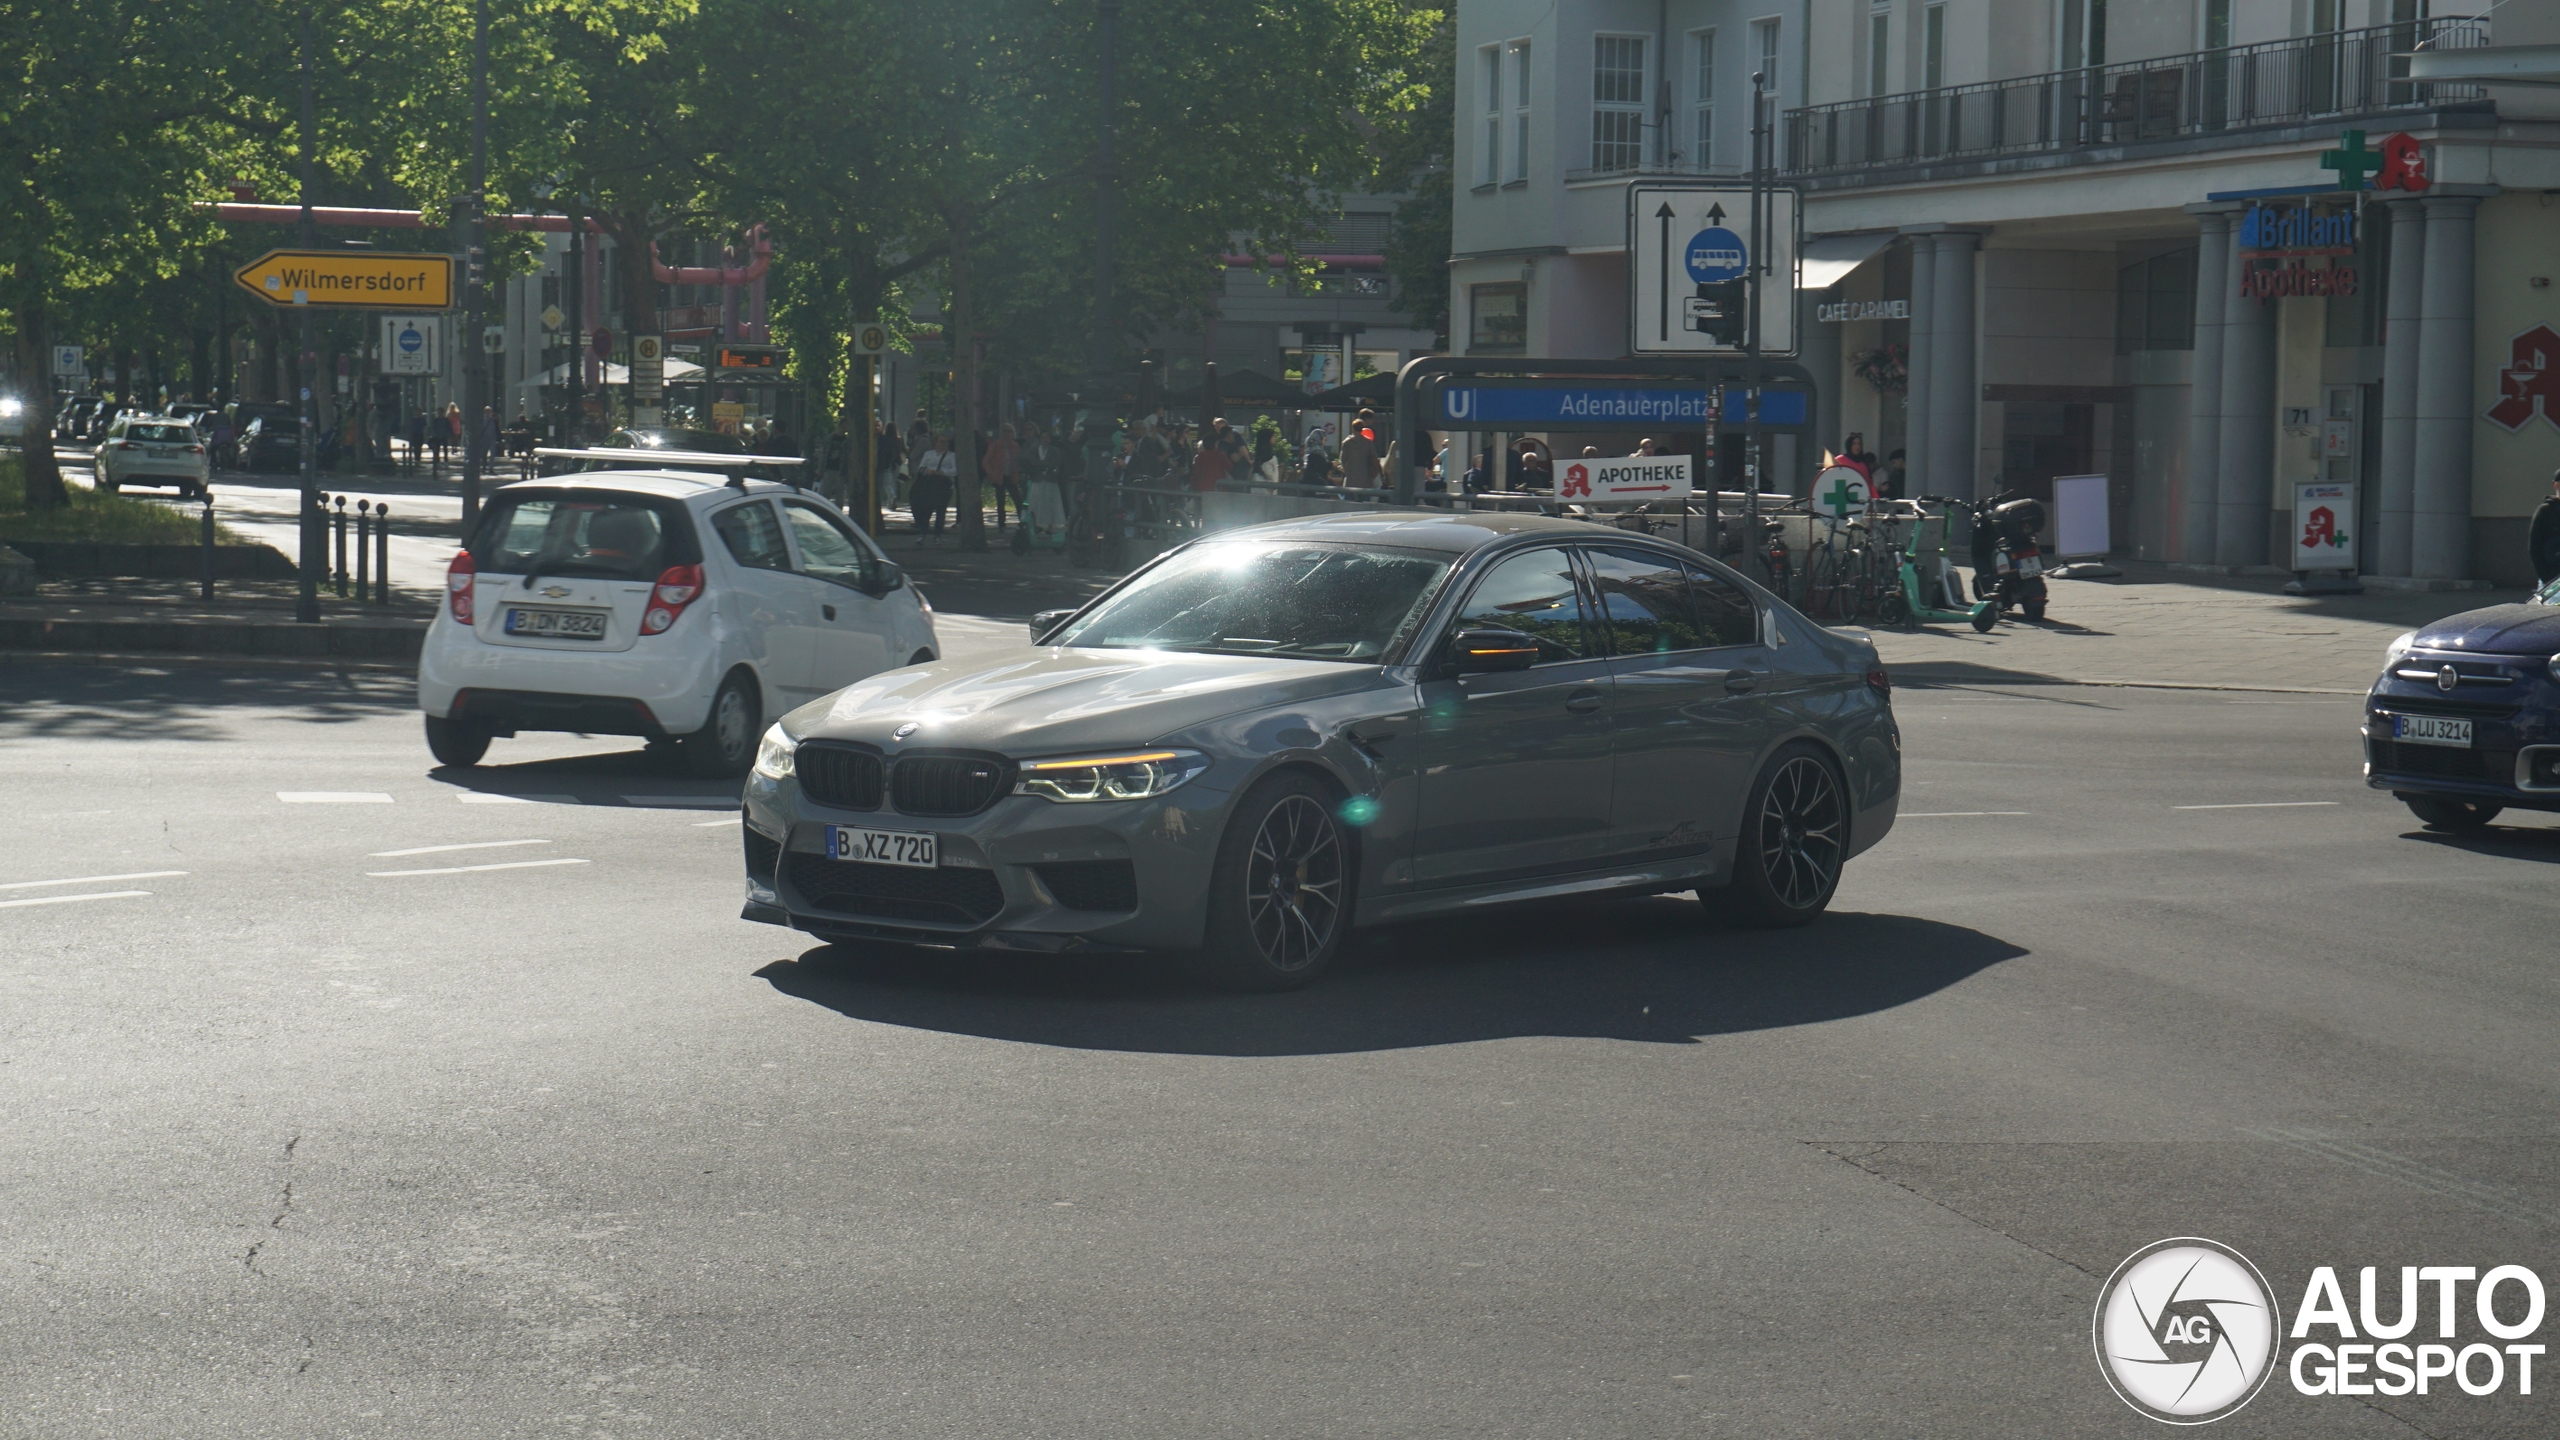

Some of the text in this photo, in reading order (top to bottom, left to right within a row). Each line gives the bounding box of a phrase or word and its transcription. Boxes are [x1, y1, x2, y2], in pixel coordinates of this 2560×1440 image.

[2260, 207, 2354, 248] Brillant
[281, 268, 426, 292] Wilmersdorf
[2238, 256, 2357, 300] Apotheke
[1817, 299, 1911, 322] CAFÉ CARAMEL
[1448, 390, 1470, 418] U
[2292, 409, 2309, 424] 71
[1597, 464, 1685, 484] APOTHEKE
[2401, 717, 2471, 741] B LU 3214
[837, 830, 851, 856] B
[863, 832, 891, 859] XZ
[894, 834, 934, 864] 720
[1649, 830, 1715, 847] SCHNITZER
